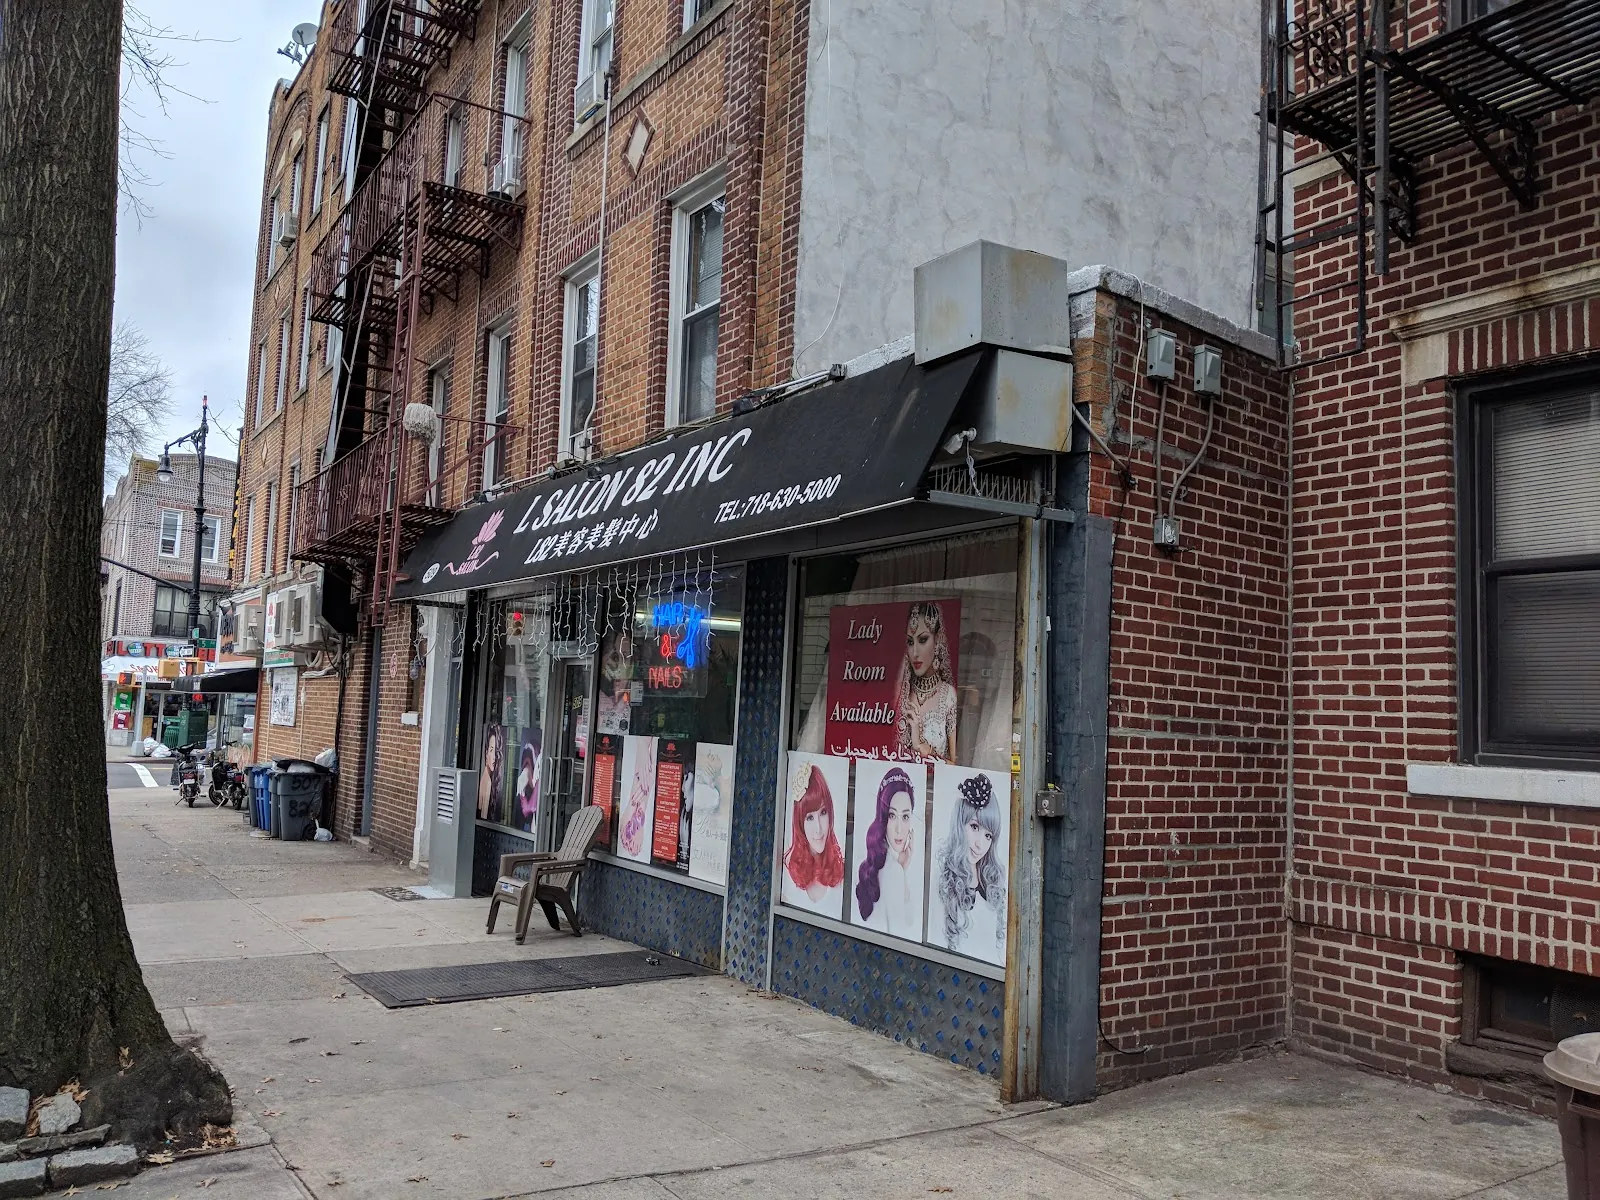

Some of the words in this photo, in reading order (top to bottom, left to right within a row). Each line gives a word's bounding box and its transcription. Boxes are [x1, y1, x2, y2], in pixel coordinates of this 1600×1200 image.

[513, 495, 542, 534] L
[532, 466, 634, 531] SALON
[621, 452, 676, 507] 82
[663, 428, 752, 495] INC
[847, 618, 883, 644] Lady
[661, 634, 671, 657] &
[648, 665, 682, 690] NAILS
[843, 660, 886, 681] Room
[830, 701, 895, 725] Available
